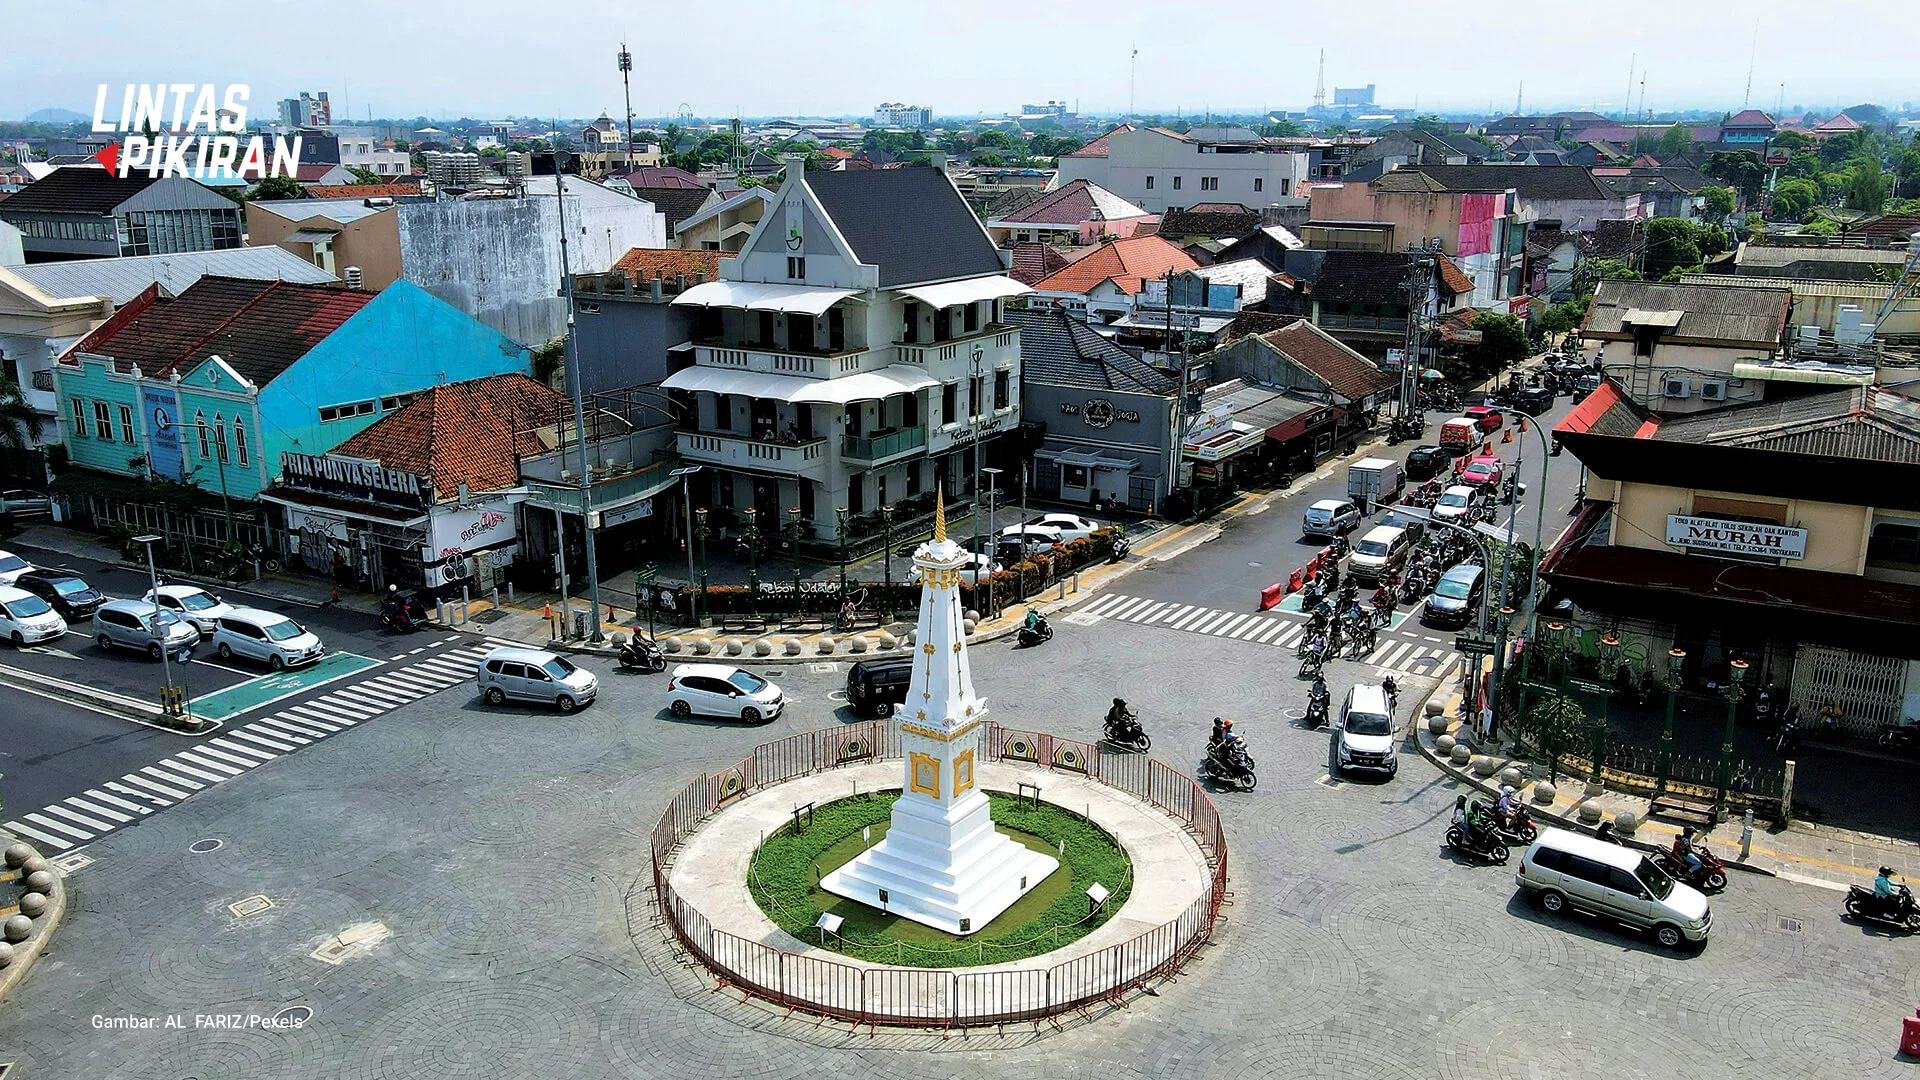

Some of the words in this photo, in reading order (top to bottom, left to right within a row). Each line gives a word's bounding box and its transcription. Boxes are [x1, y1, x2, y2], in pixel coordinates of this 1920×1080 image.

[280, 451, 314, 476] PRIA
[313, 457, 363, 486] PUNYA
[362, 464, 420, 495] SELERA
[1674, 517, 1688, 525] TOKO
[1690, 519, 1718, 528] ALAT-ALAT
[1721, 522, 1736, 530] TULIS
[1738, 525, 1763, 533] SEKOLAH
[1777, 528, 1800, 537] KANTOR
[1688, 527, 1783, 547] MURAH
